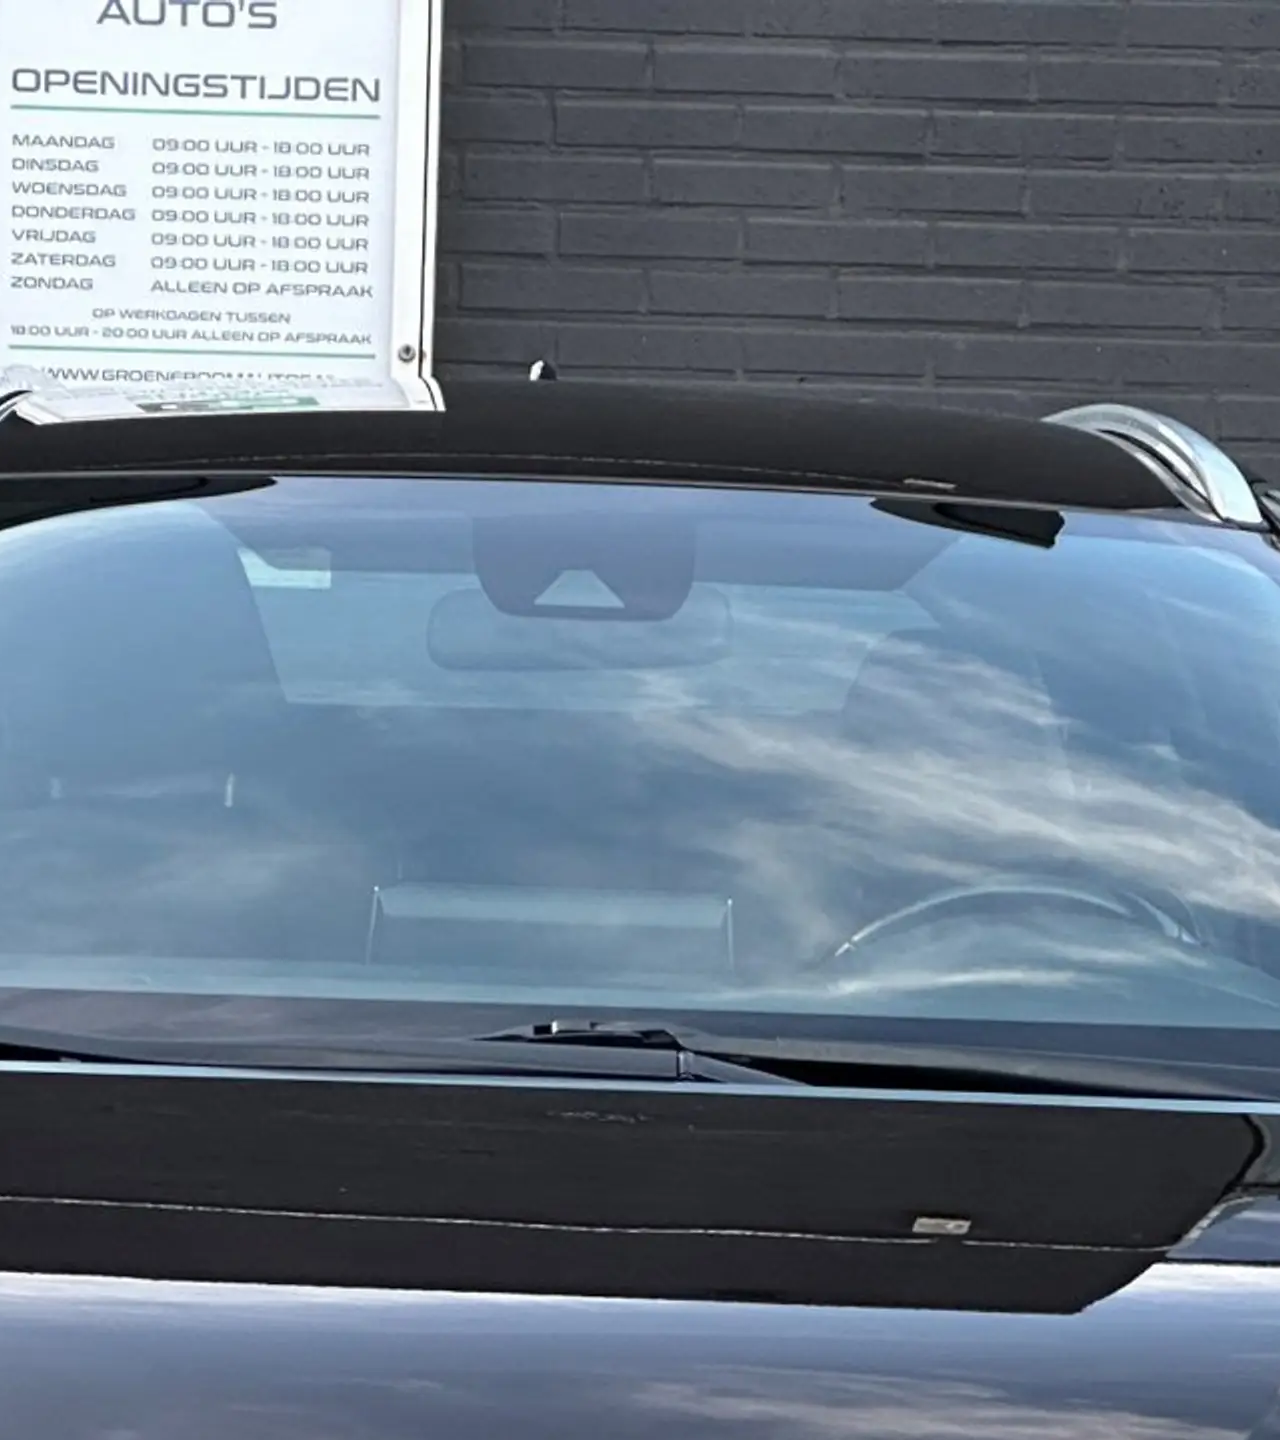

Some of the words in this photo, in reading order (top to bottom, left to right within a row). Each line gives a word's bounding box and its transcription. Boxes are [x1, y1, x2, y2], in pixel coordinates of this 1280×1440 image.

[96, 0, 277, 29] AUTO'S
[12, 68, 380, 102] OPENINGSTIJDEN
[12, 134, 115, 149] MAANDAG
[215, 140, 257, 154] UUR
[327, 143, 370, 157] UUR
[12, 157, 99, 172] DINSDAG
[215, 164, 257, 178] UUR
[327, 167, 370, 181] UUR
[12, 181, 127, 196] WOENSDAG
[215, 187, 257, 201] UUR
[327, 190, 370, 204] UUR
[12, 205, 136, 220] DONDERDAG
[214, 211, 256, 225] UUR
[326, 214, 369, 228] UUR
[12, 228, 96, 243] VRIJDAG
[214, 234, 256, 248] UUR
[326, 237, 369, 251] UUR
[10, 252, 116, 267] ZATERDAG
[213, 258, 255, 272] UUR
[325, 261, 368, 275] UUR
[10, 275, 93, 290] ZONDAG
[150, 279, 227, 294] ALLEEN
[232, 282, 260, 295] OP
[265, 283, 373, 298] AFSPRAAK
[92, 307, 115, 319] OP
[119, 309, 221, 322] WERKDAGEN
[227, 311, 291, 324] TUSSEN
[54, 326, 89, 338] UUR
[152, 329, 187, 340] UUR
[191, 330, 253, 342] ALLEEN
[257, 332, 280, 343] OP
[284, 332, 372, 344] AFSPRAAK
